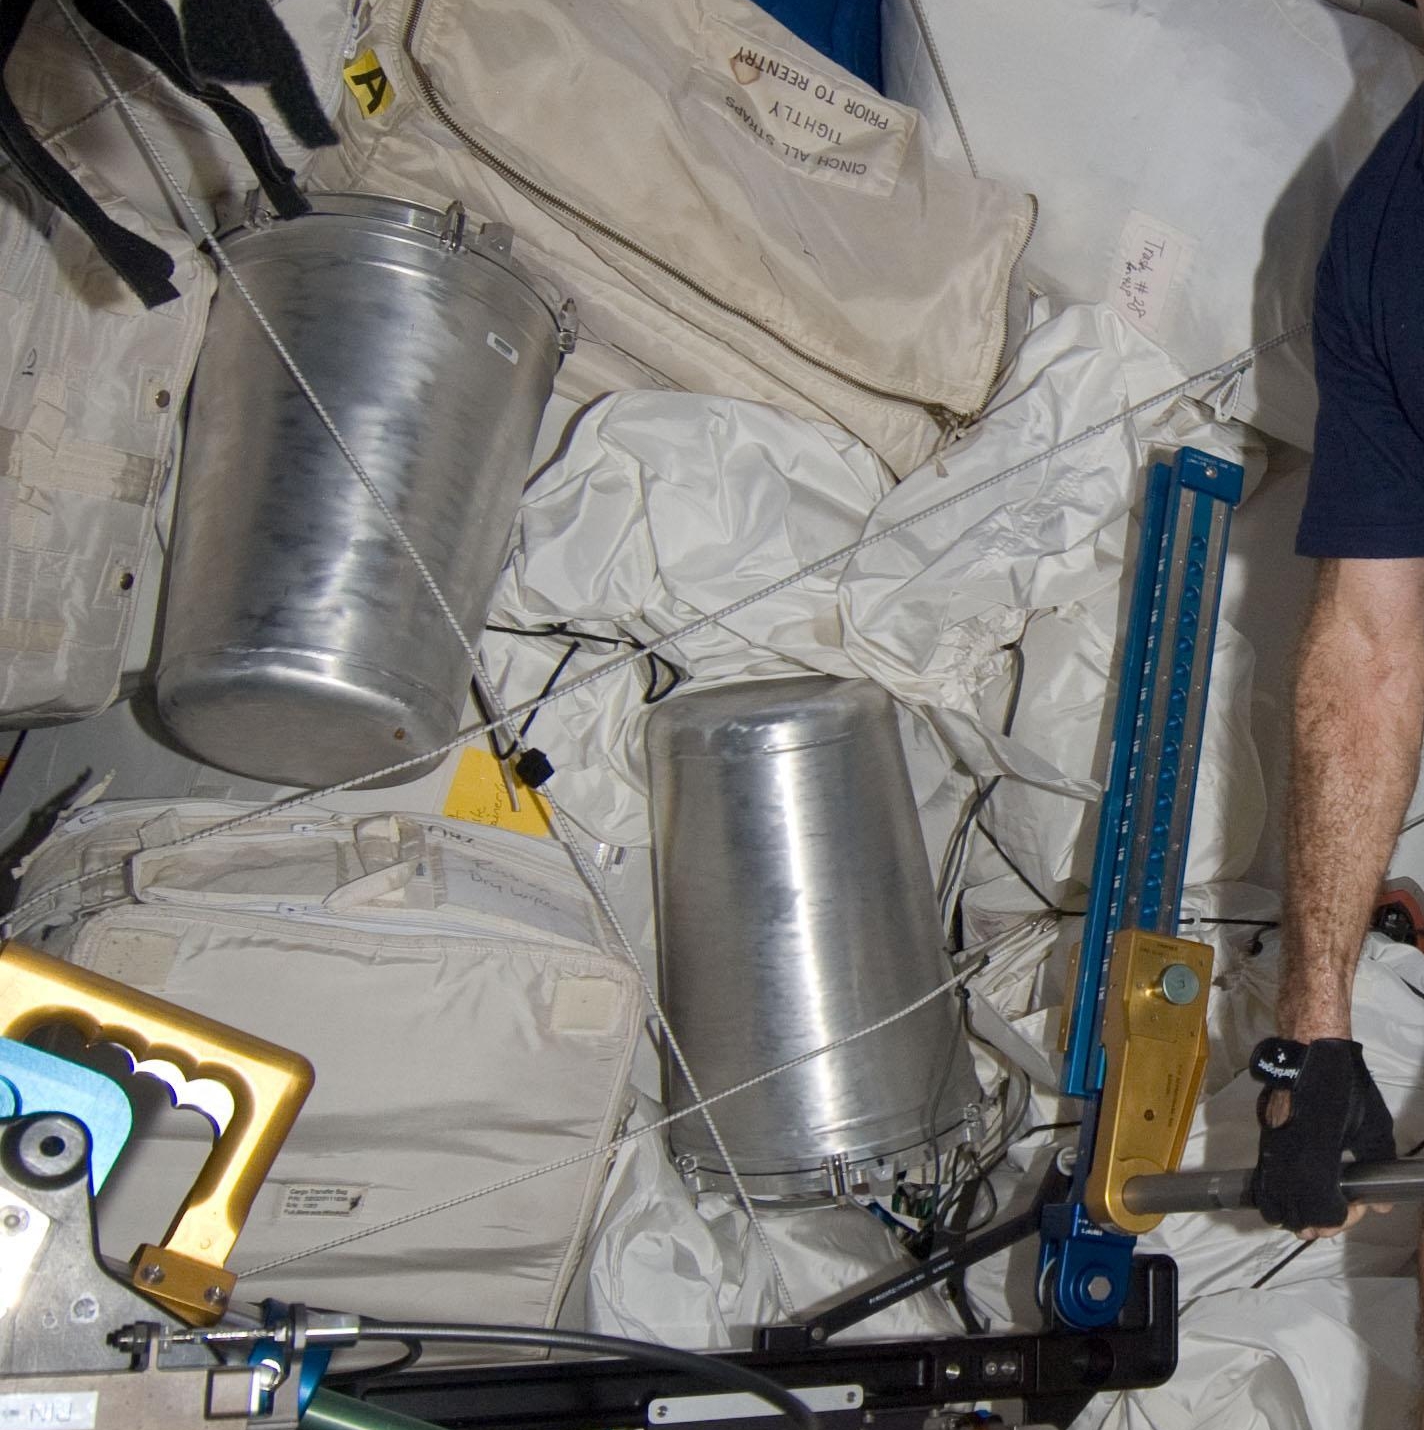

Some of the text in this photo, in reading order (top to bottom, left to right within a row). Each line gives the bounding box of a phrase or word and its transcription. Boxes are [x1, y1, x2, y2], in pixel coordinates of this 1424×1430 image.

[351, 66, 388, 115] A
[734, 46, 890, 131] PRIOR TO REENTRY
[725, 95, 868, 176] CINCH ALL STRAPS
[768, 100, 842, 146] TIGHTLY
